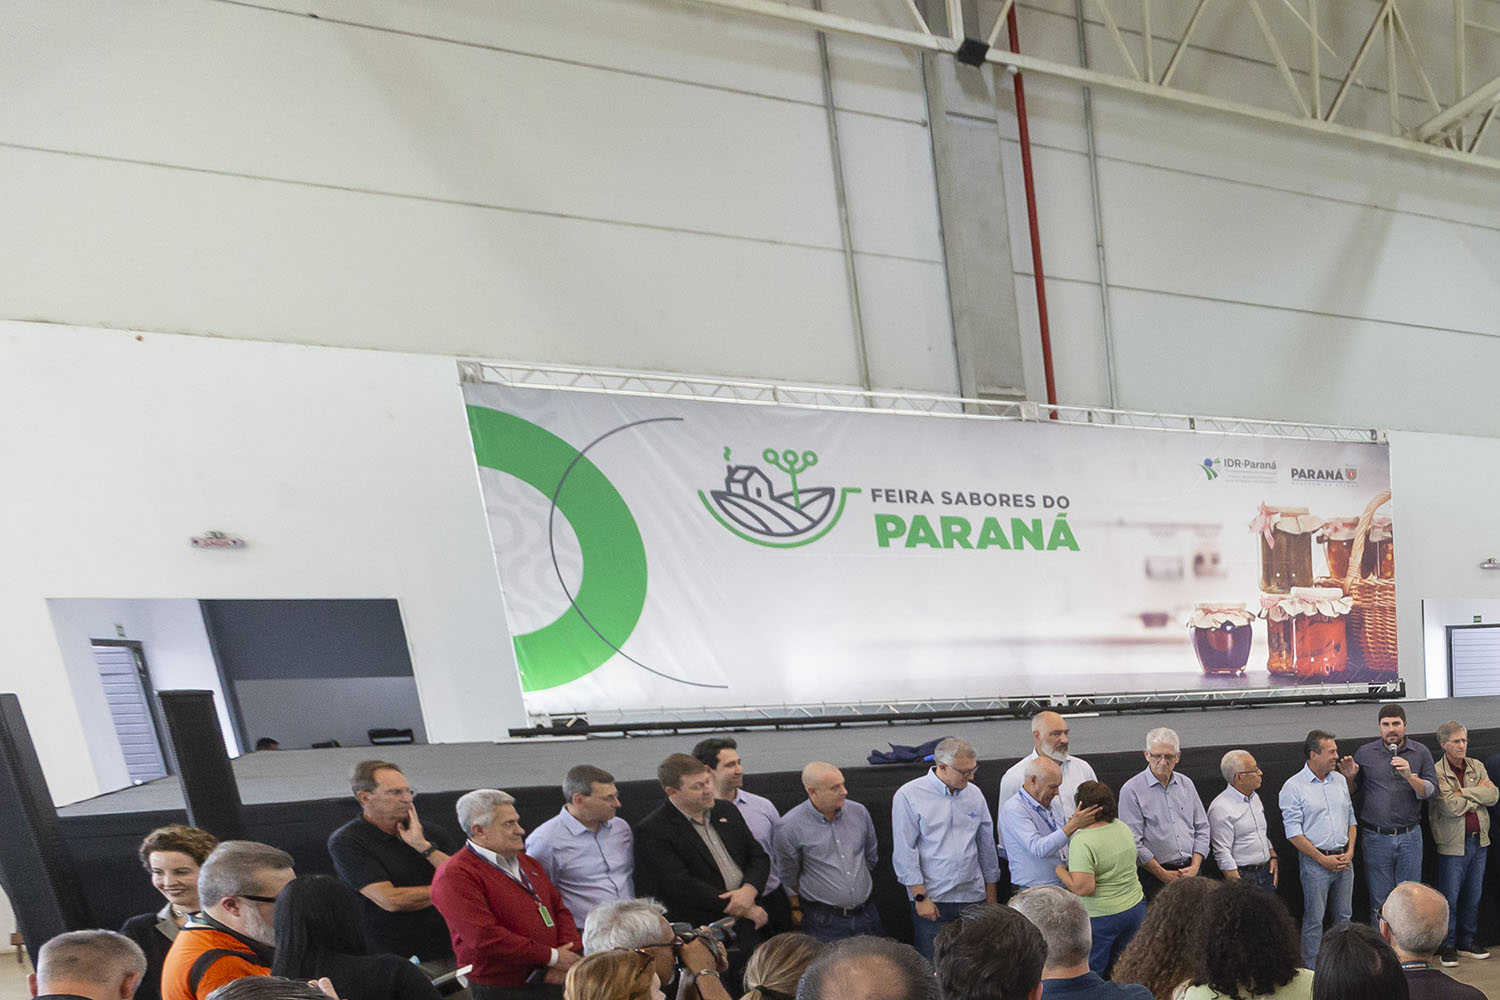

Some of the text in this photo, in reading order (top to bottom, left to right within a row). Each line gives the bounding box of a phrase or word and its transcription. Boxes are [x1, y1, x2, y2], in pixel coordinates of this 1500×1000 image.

[1290, 467, 1344, 481] PARANÁ
[870, 488, 1070, 509] FEIRA SABORES DO
[874, 512, 1081, 551] PARANÁ
